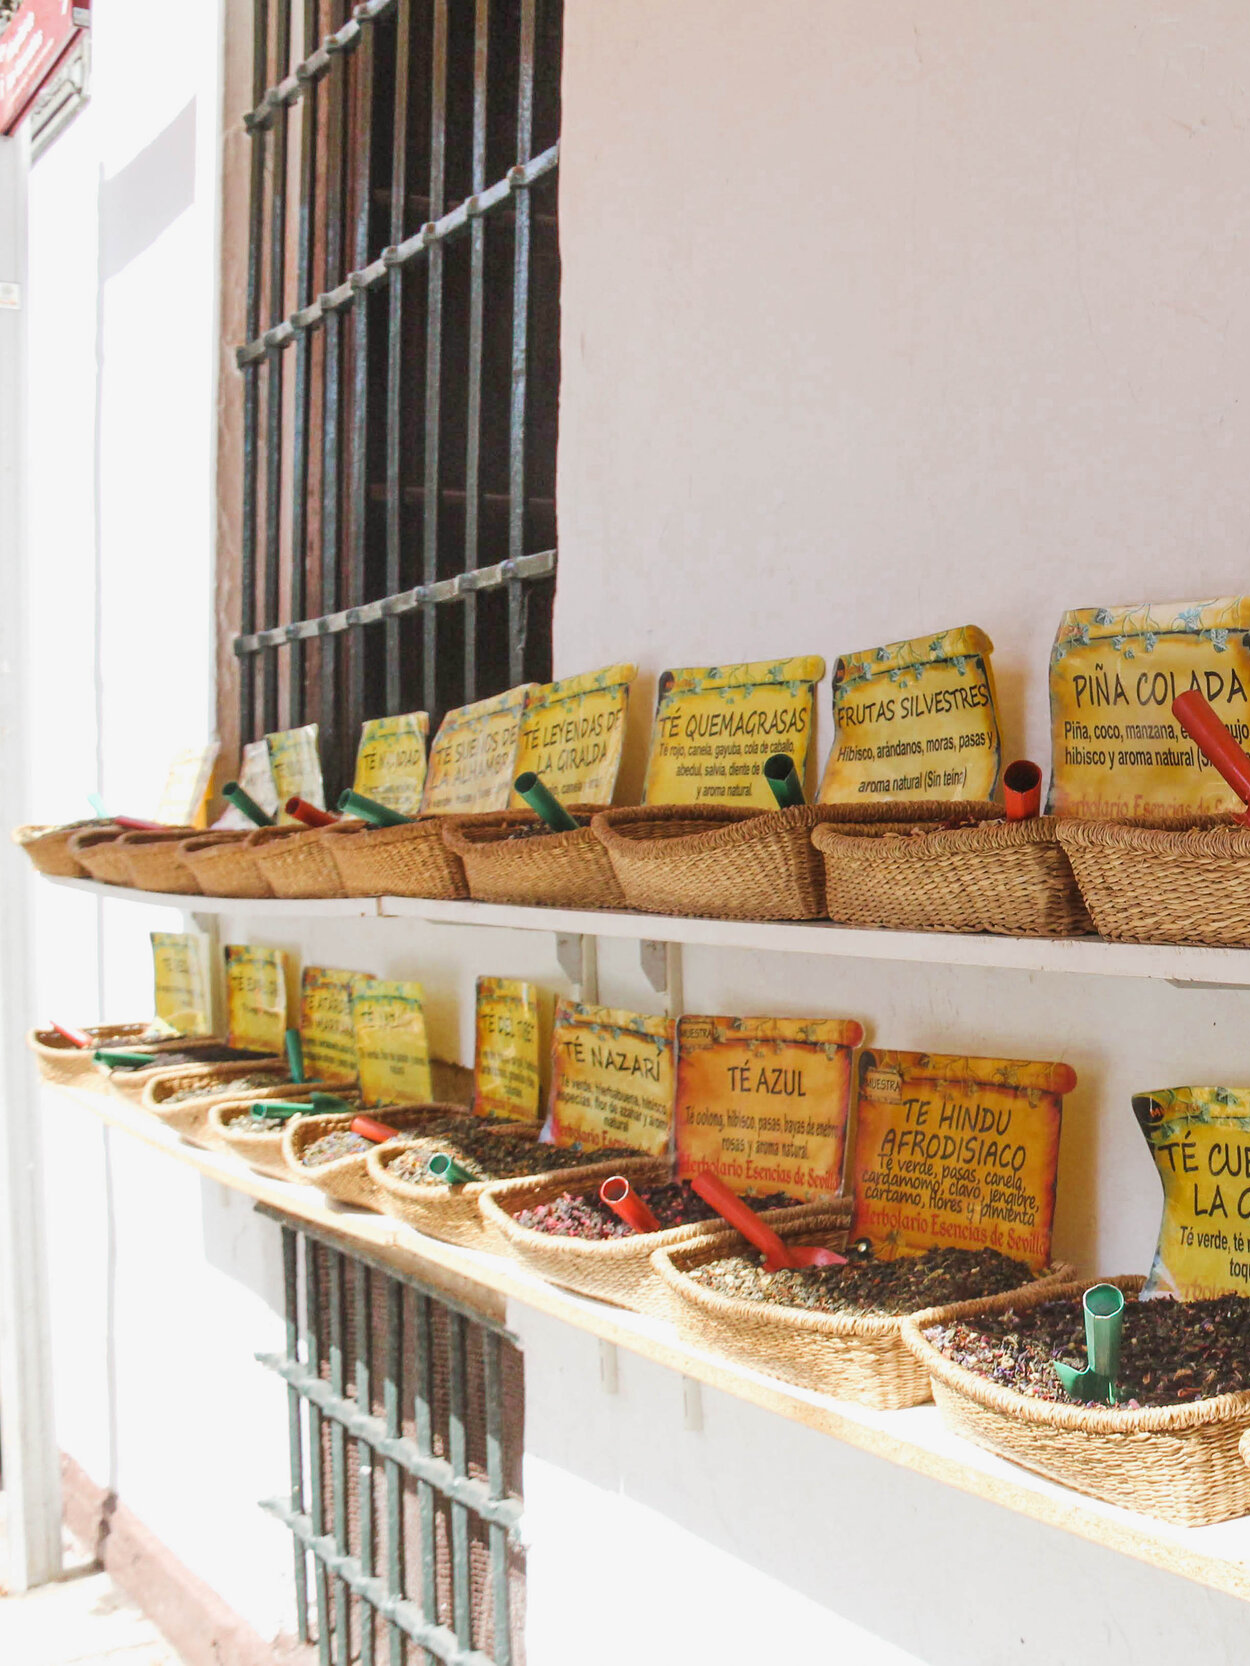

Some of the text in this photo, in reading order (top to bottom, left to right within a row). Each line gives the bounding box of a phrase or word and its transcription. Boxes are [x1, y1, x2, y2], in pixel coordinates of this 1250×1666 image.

[1073, 663, 1248, 708] PIÑA COLADA
[838, 683, 989, 728] FRUTAS SILVESTRES
[502, 725, 517, 746] DE
[524, 709, 622, 749] TÉ LEYENDAS DE
[660, 707, 806, 741] TÉ QUEMAGRASAS
[1064, 720, 1092, 742] Piña,
[1094, 724, 1123, 742] coco,
[1126, 724, 1178, 742] manzana,
[537, 741, 606, 775] LA GIRALDA
[660, 742, 668, 757] Té
[744, 741, 758, 753] cola
[760, 740, 768, 752] de
[837, 731, 993, 762] Hibisco, arándanos, moras, pasas y
[1065, 748, 1194, 770] hibisco y aroma natural
[751, 762, 760, 775] de
[858, 781, 890, 793] aroma
[893, 773, 922, 791] natural
[924, 770, 941, 792] (Sin
[696, 786, 702, 799] y
[703, 786, 726, 797] aroma
[563, 1035, 663, 1082] TÉ NAZARÍ
[728, 1059, 806, 1097] TÉ AZUL
[806, 1115, 815, 1135] de
[902, 1098, 1012, 1135] TE HINDU
[881, 1128, 1026, 1172] AFRODISIACO
[1159, 1131, 1199, 1172] TÉ
[794, 1165, 805, 1185] de
[898, 1156, 938, 1178] verde,
[942, 1165, 981, 1185] pasas,
[985, 1170, 1027, 1192] canela,
[967, 1202, 975, 1221] y
[980, 1201, 1036, 1227] pimienta
[1194, 1183, 1228, 1218] LA
[931, 1214, 987, 1244] Esencias
[990, 1228, 1004, 1246] de
[1180, 1225, 1194, 1246] Té
[1197, 1230, 1231, 1254] verde,
[1233, 1232, 1244, 1252] té
